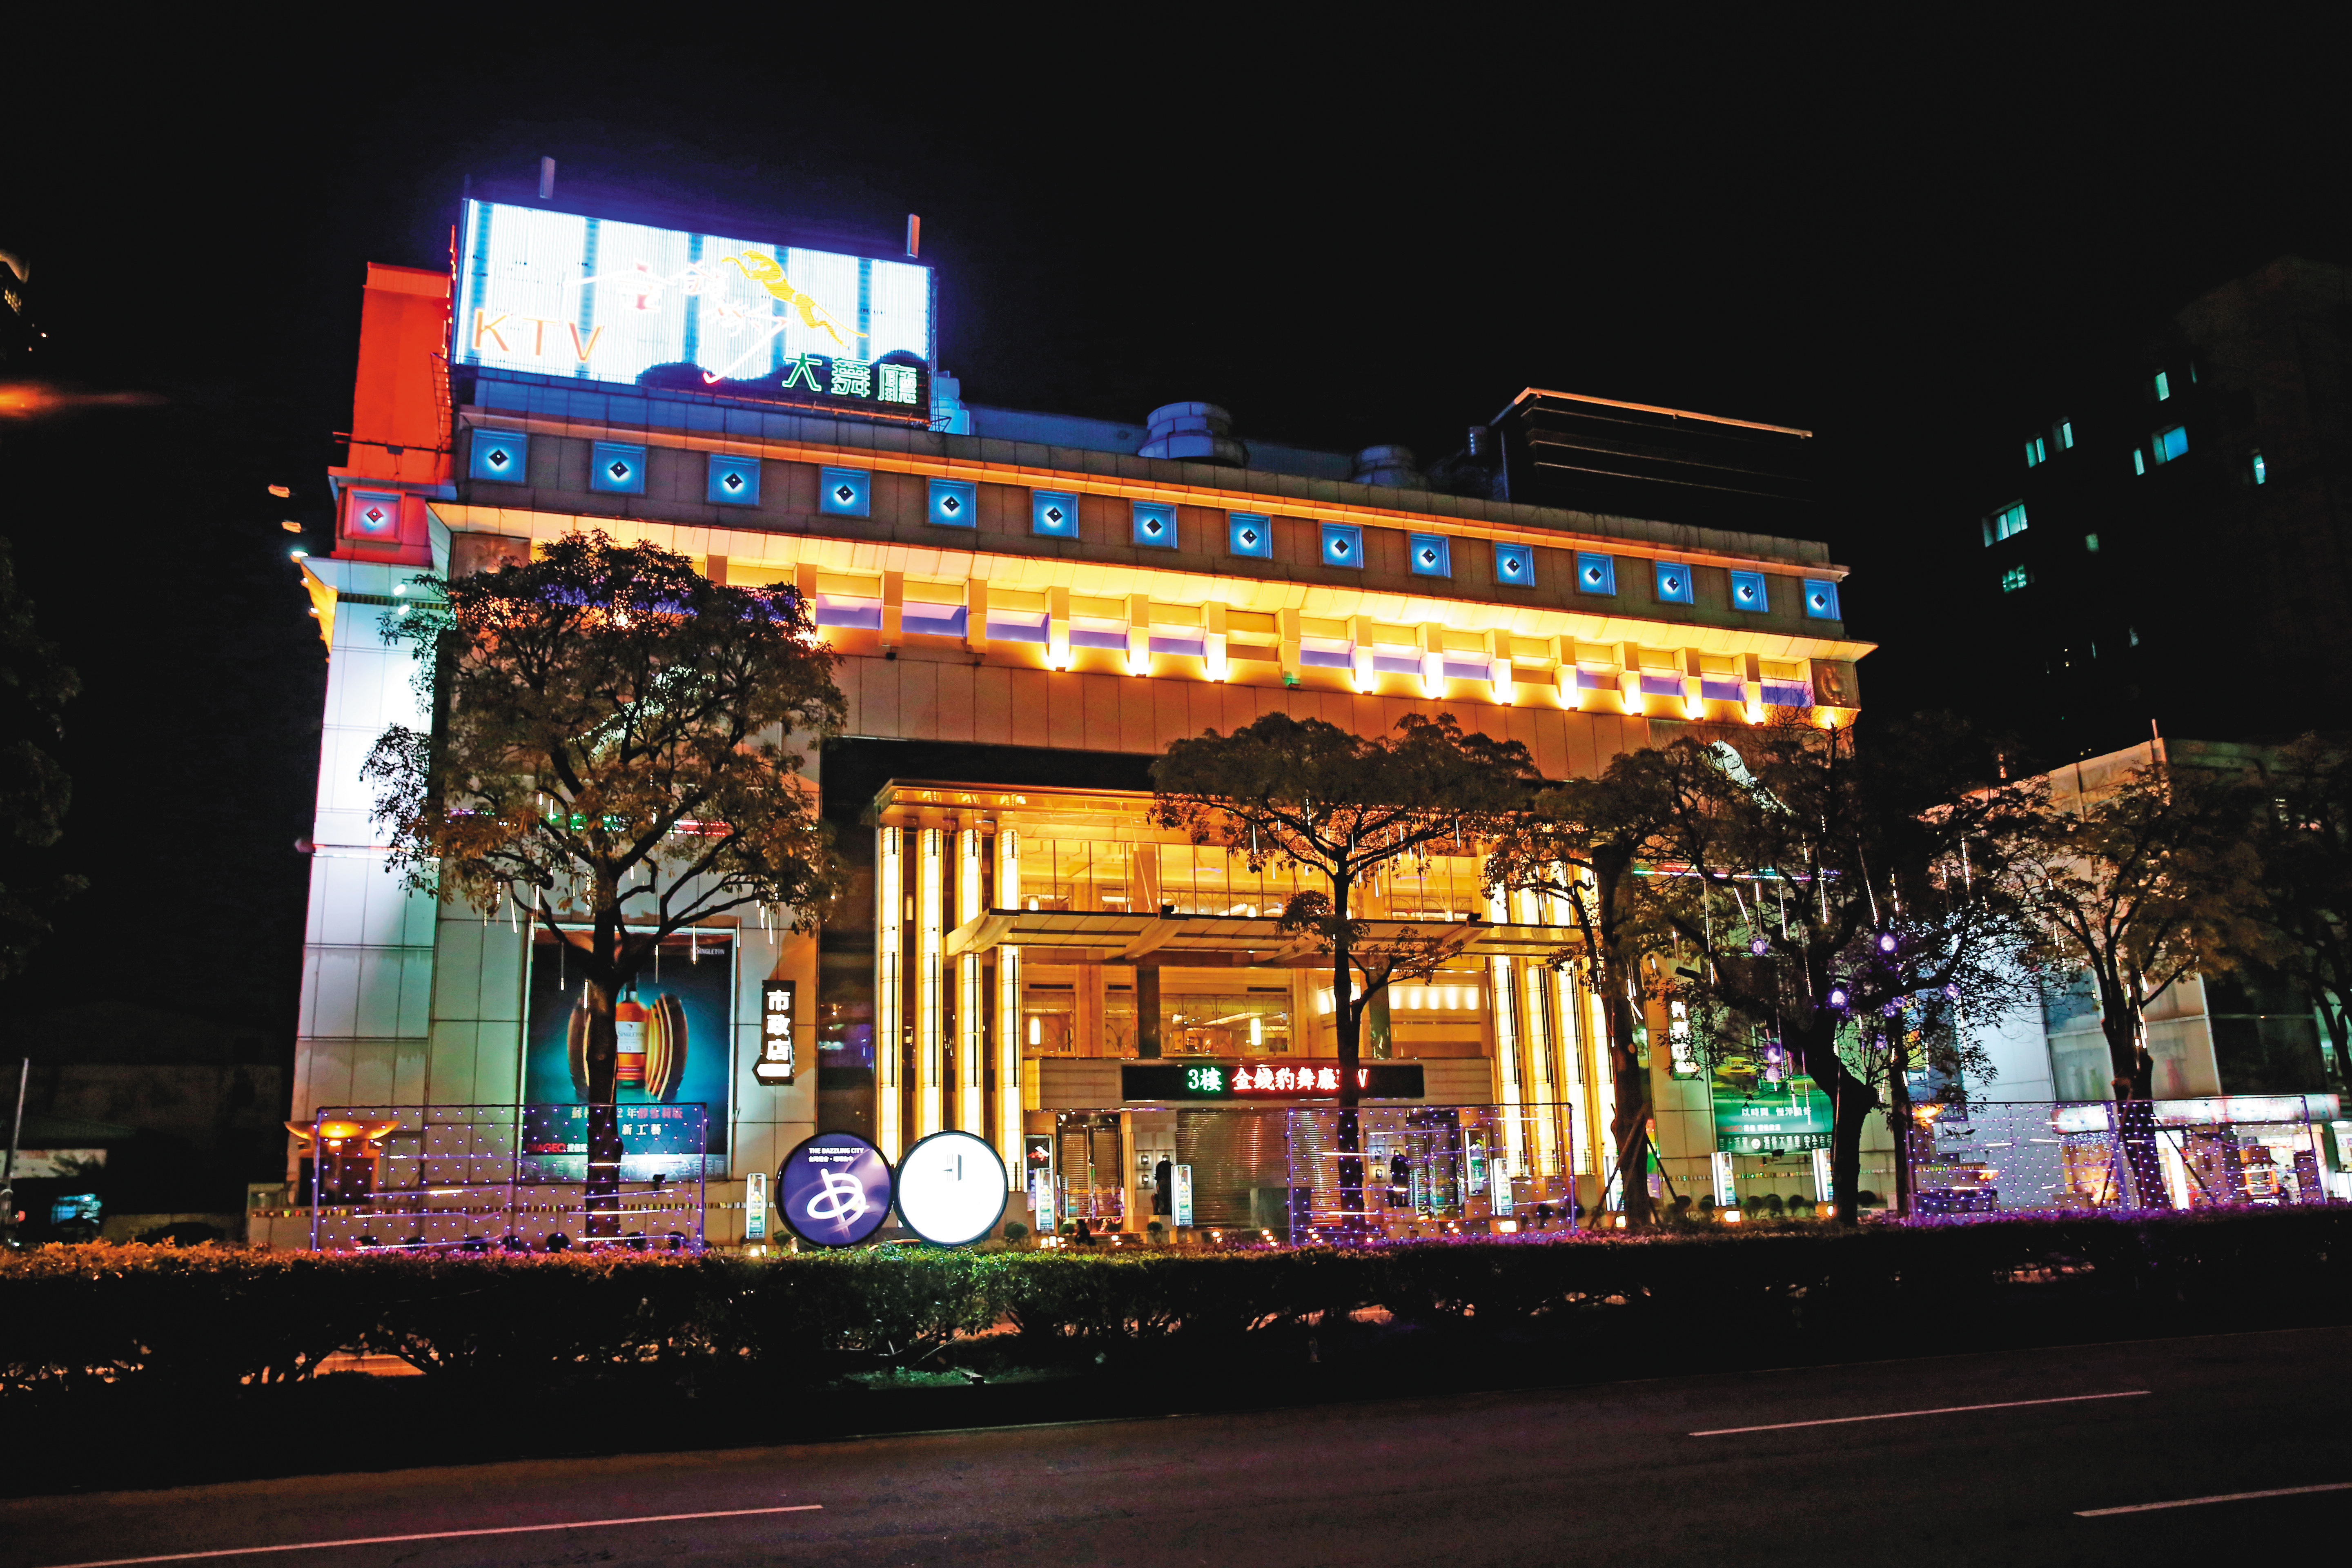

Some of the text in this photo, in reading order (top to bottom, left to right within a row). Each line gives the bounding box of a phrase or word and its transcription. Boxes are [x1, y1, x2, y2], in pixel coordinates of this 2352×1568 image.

[472, 307, 605, 363] KTV
[782, 352, 918, 404] 大舞廳
[766, 989, 791, 1061] 市政店
[1188, 1067, 1222, 1091] 3樓
